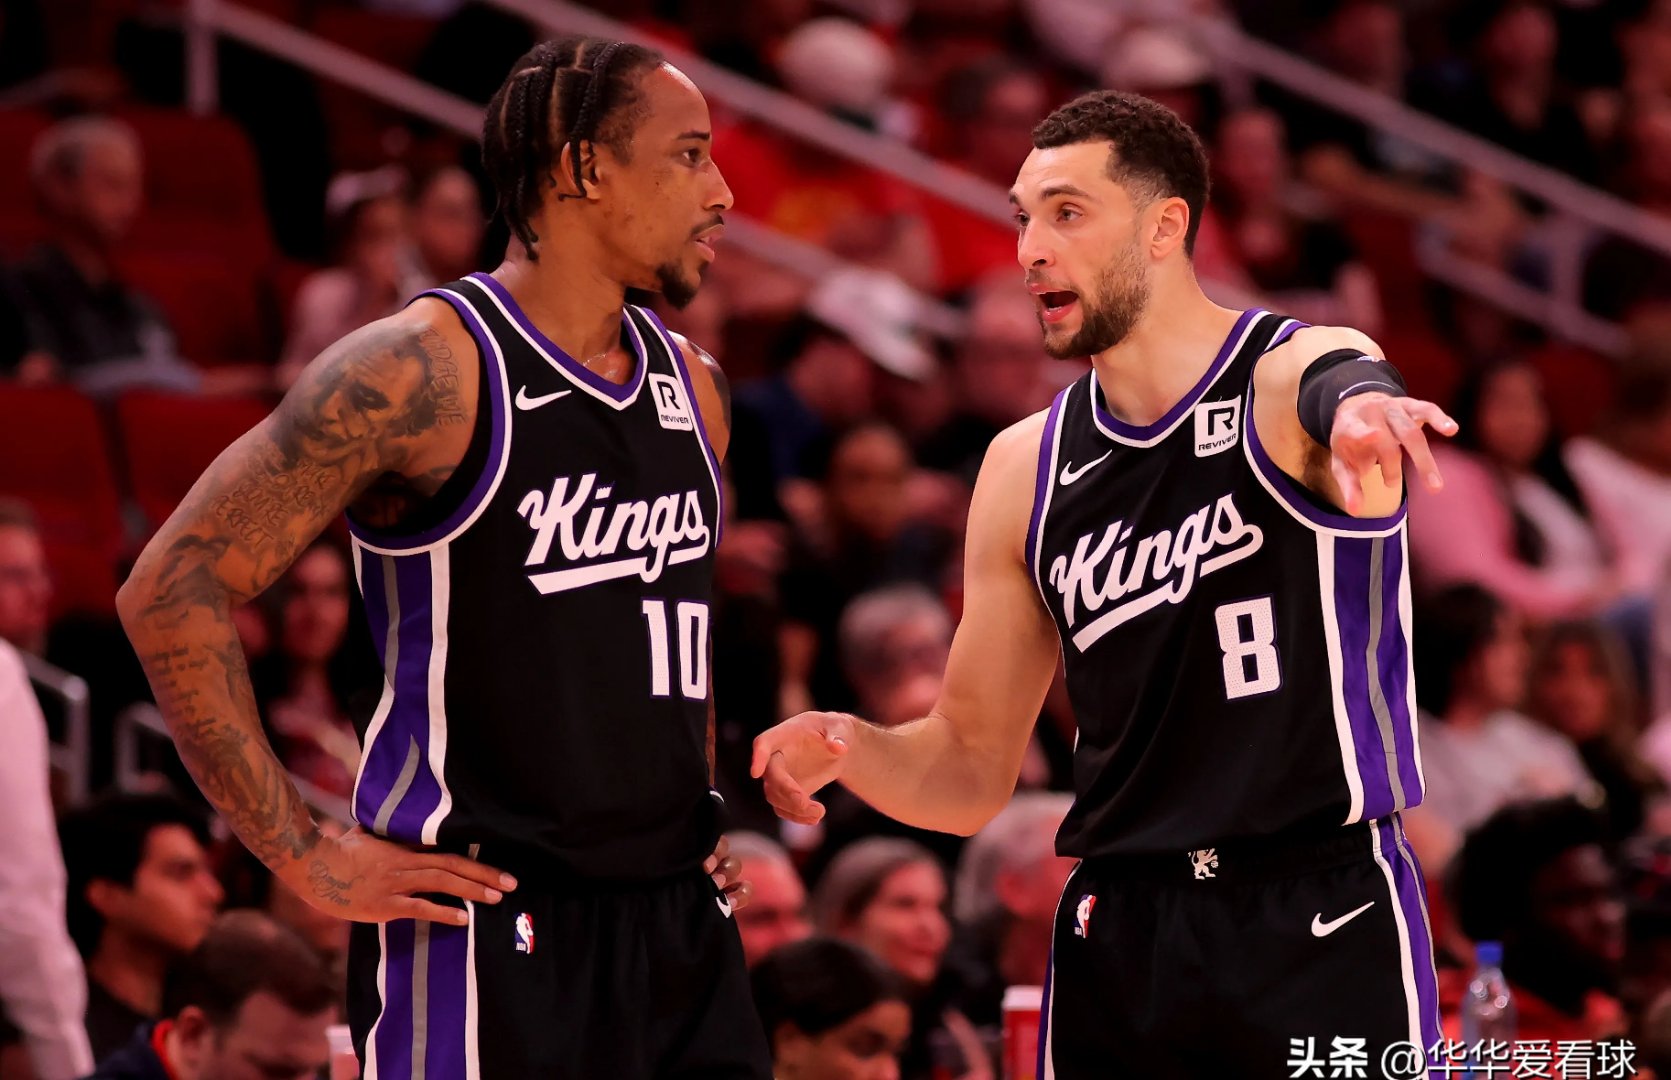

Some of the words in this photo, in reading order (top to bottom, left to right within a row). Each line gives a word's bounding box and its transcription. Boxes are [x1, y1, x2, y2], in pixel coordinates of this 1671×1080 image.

[656, 380, 681, 410] R
[660, 414, 689, 424] REVIVER
[1207, 406, 1235, 436] R
[1198, 432, 1237, 451] REVIVER
[517, 473, 709, 595] Kings
[1049, 493, 1263, 653] Kings
[642, 600, 708, 700] 10
[1214, 596, 1282, 700] 8
